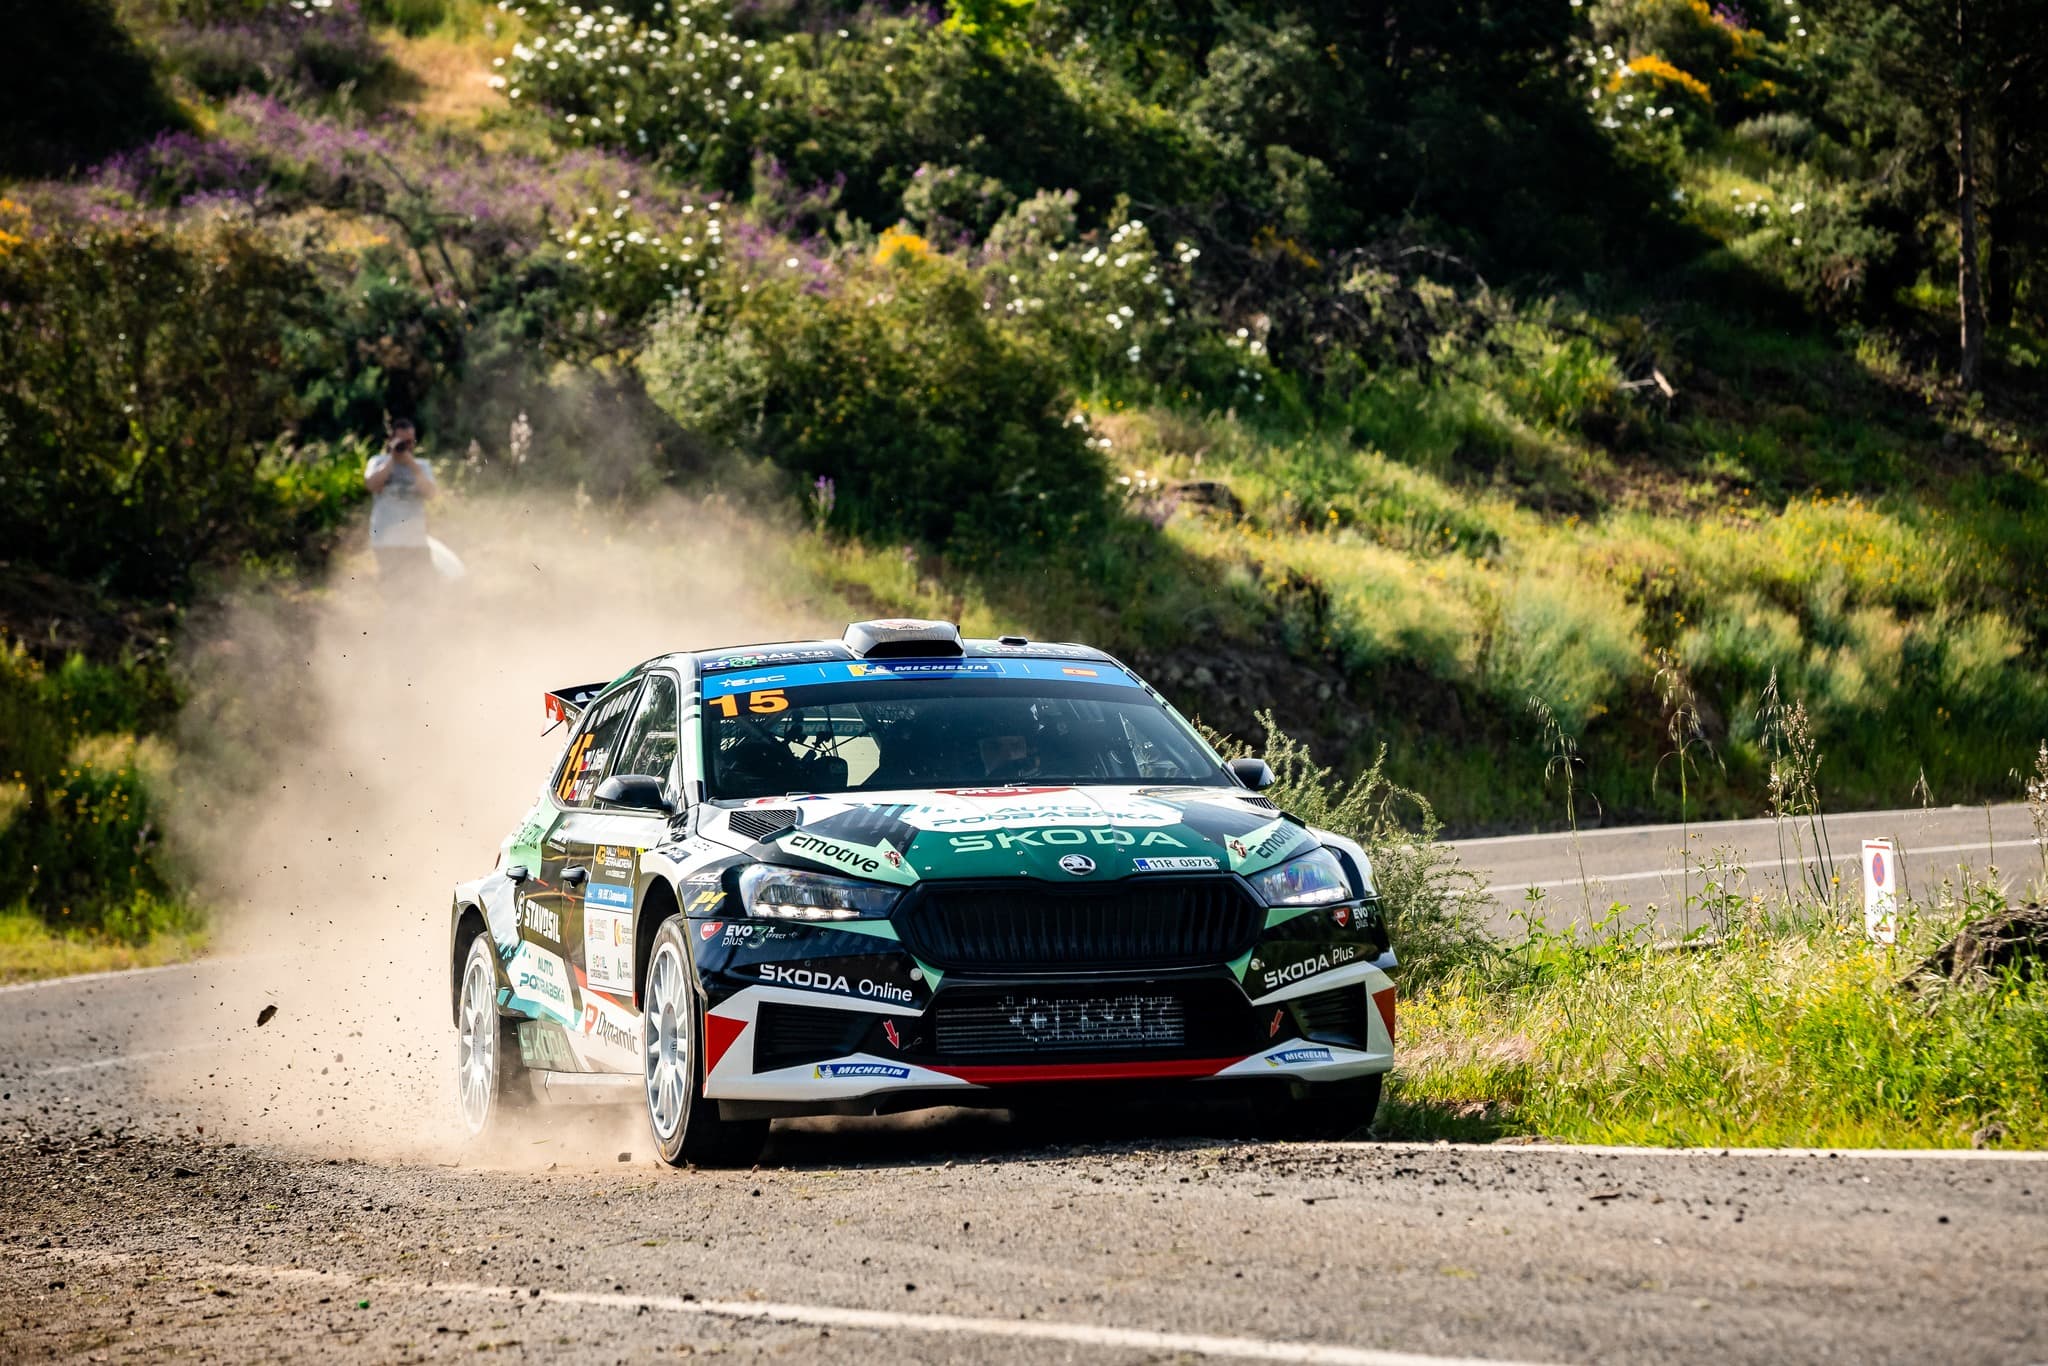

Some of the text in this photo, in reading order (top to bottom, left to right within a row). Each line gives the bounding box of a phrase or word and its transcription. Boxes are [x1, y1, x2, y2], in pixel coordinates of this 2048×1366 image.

[894, 664, 989, 672] MICHELIN
[708, 689, 789, 718] 15
[790, 835, 880, 873] emotive
[1149, 859, 1175, 868] 11R
[1180, 858, 1213, 867] 0878
[1352, 906, 1369, 920] EVO
[725, 924, 753, 936] EVO
[721, 936, 744, 947] plus
[1333, 946, 1354, 965] Plus
[858, 978, 913, 1001] Online
[596, 1010, 639, 1056] Dynamic
[1285, 1050, 1329, 1061] MICHELIN
[837, 1066, 904, 1076] MICHELIN
